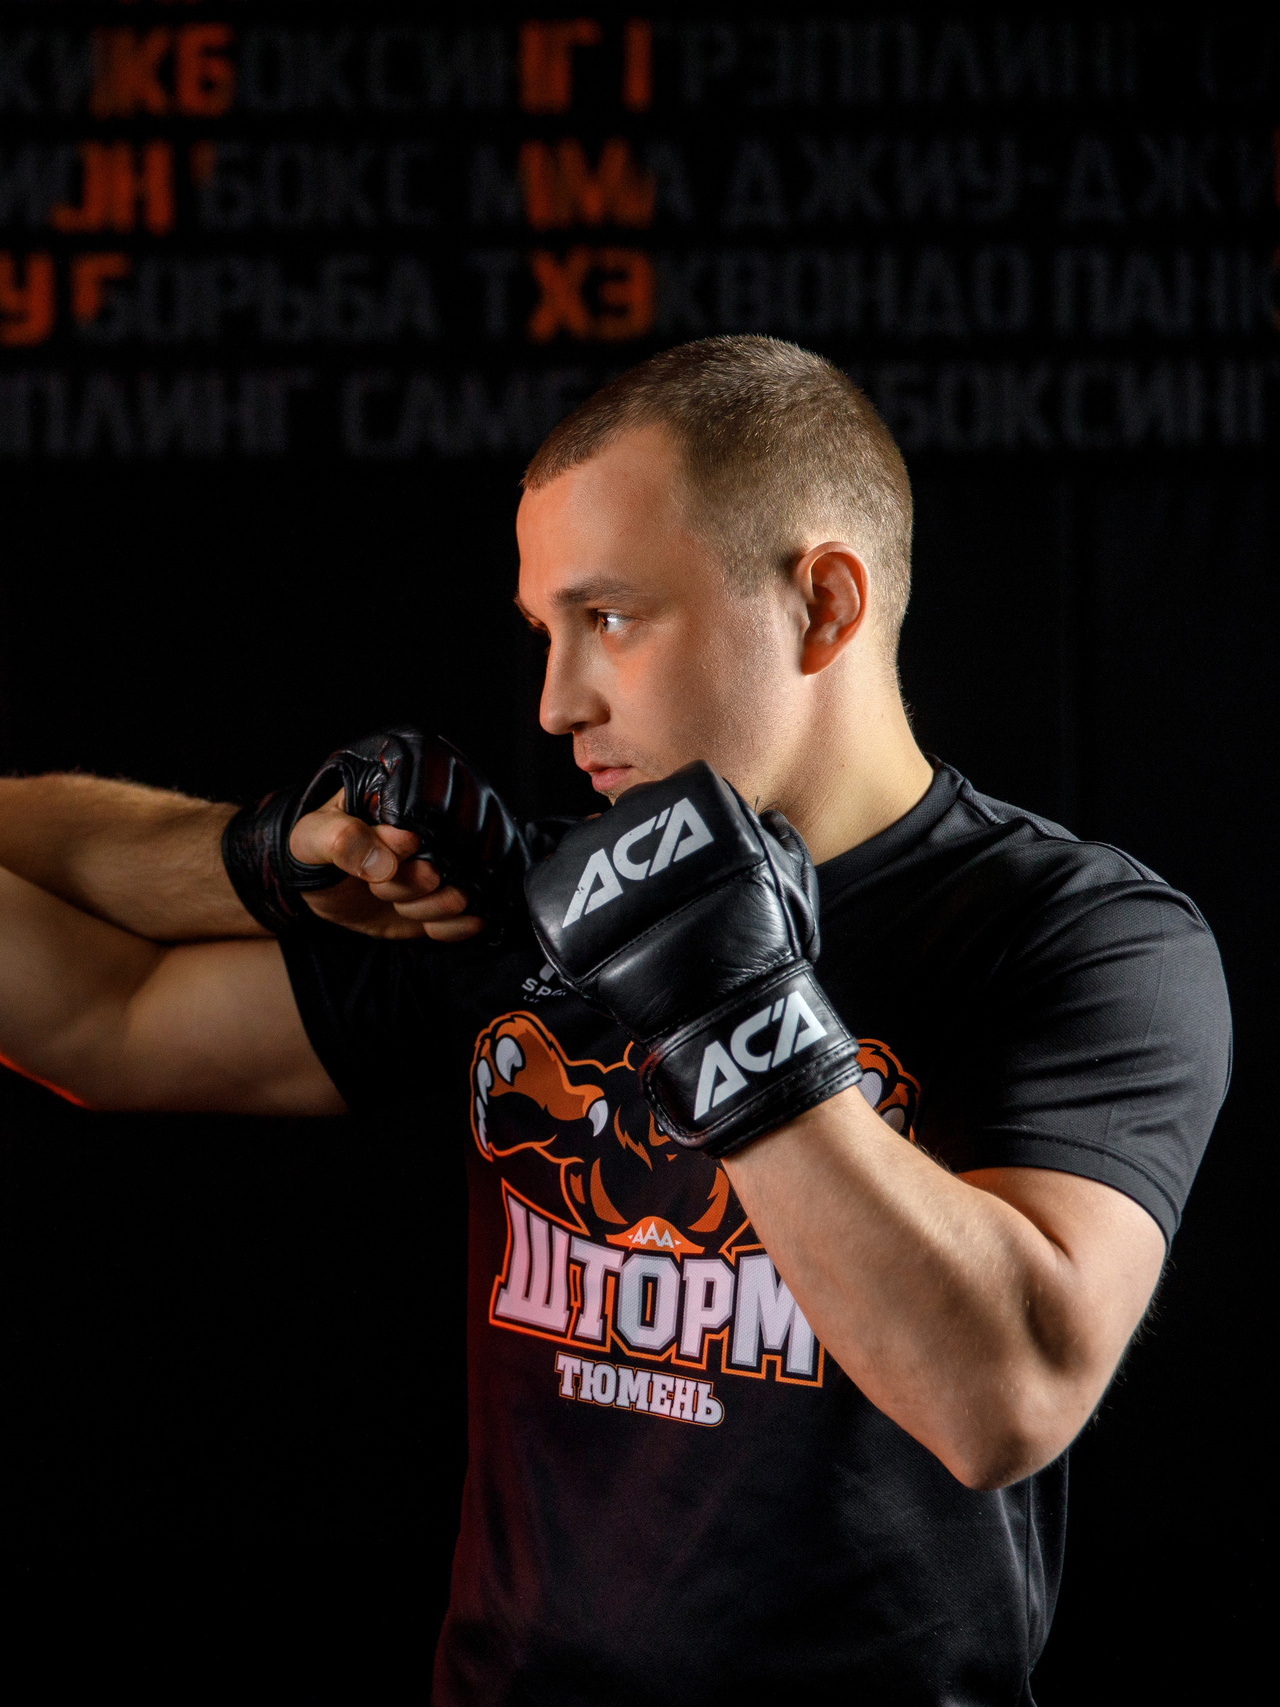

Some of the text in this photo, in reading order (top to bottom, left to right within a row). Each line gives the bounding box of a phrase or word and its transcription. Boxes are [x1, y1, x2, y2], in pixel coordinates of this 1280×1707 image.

[188, 138, 436, 232] БОКС
[465, 135, 694, 232] ММА
[68, 250, 440, 346] БОРЬБА
[465, 244, 1032, 342] ТХЭКВОНДО
[562, 797, 715, 929] ACA
[693, 990, 828, 1121] ACA
[493, 1192, 821, 1379] ШТОРМ
[555, 1352, 725, 1427] ТЮМЕНЬ
